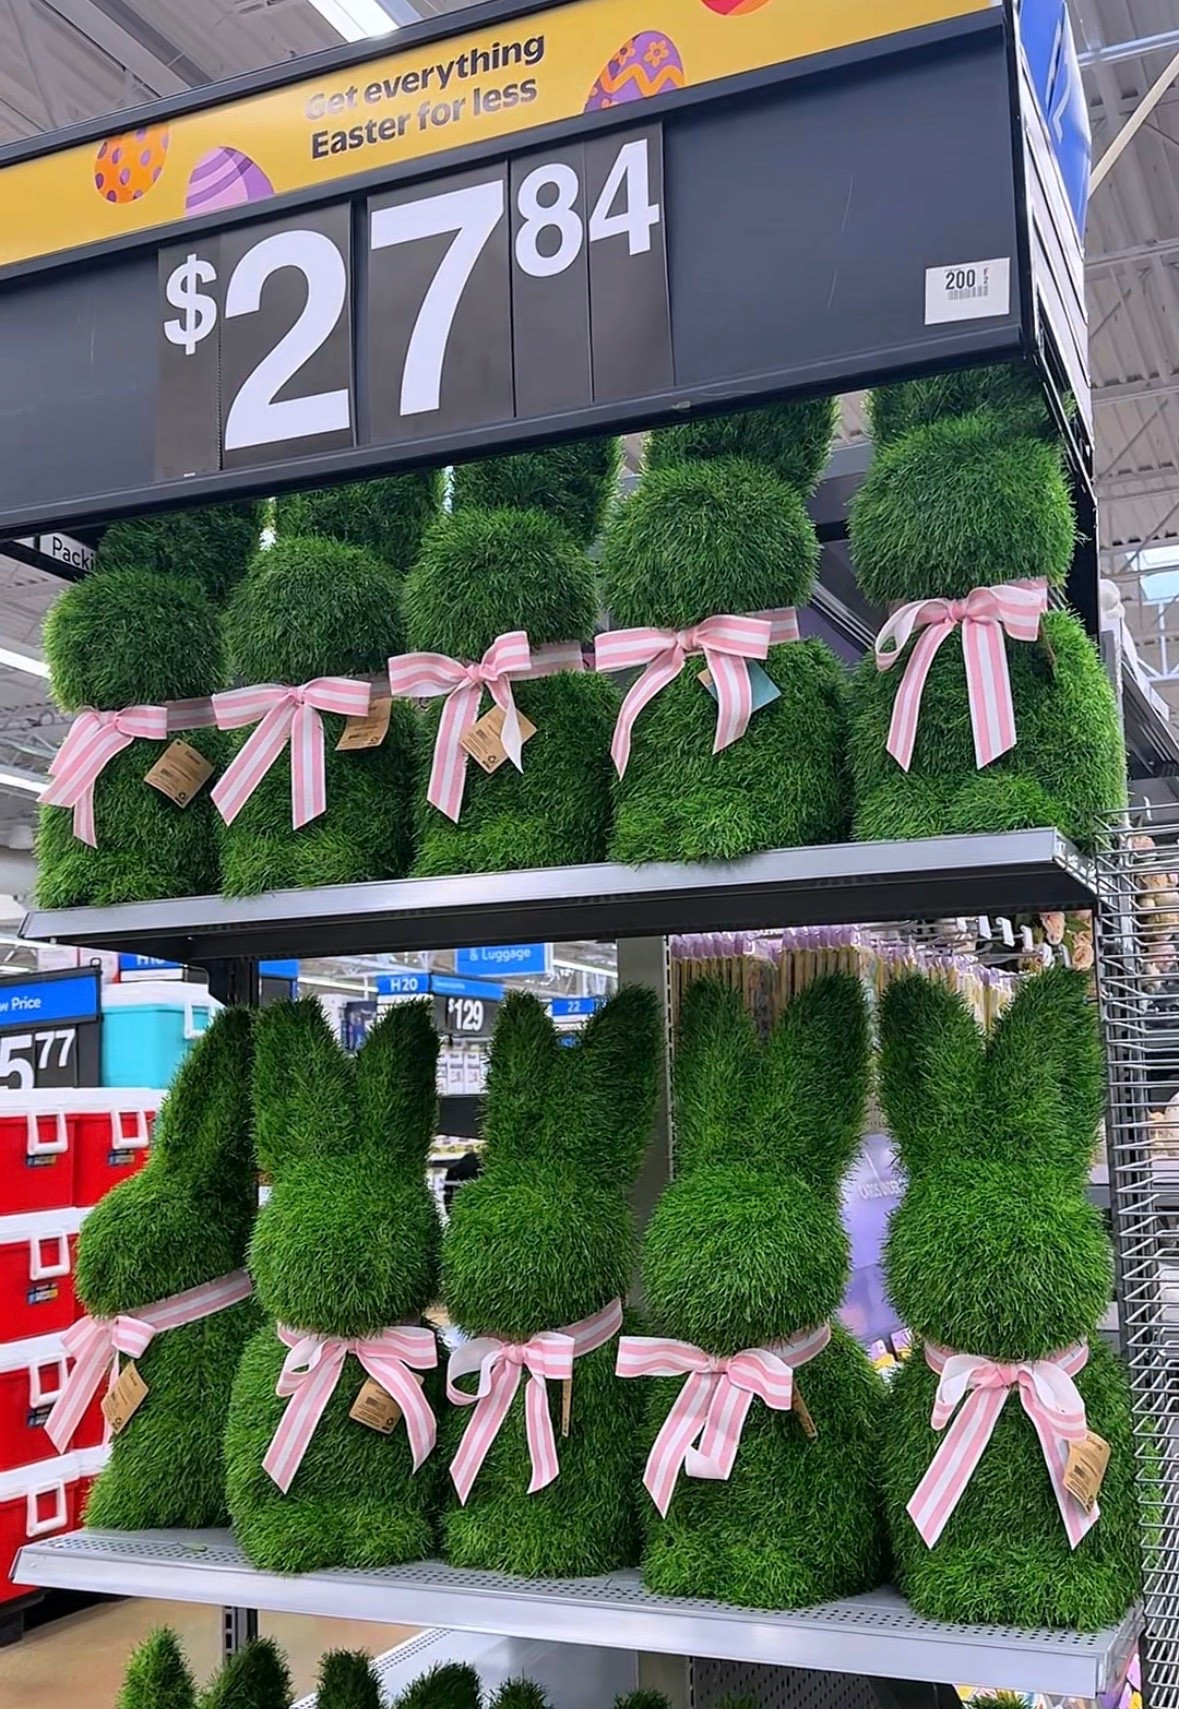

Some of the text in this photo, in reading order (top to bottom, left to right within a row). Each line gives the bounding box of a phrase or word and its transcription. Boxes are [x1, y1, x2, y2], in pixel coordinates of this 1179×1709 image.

[305, 35, 545, 121] Get everything
[311, 78, 537, 159] Easter for less
[945, 269, 976, 291] 200
[469, 947, 531, 963] & Luggage
[11, 996, 42, 1011] Price
